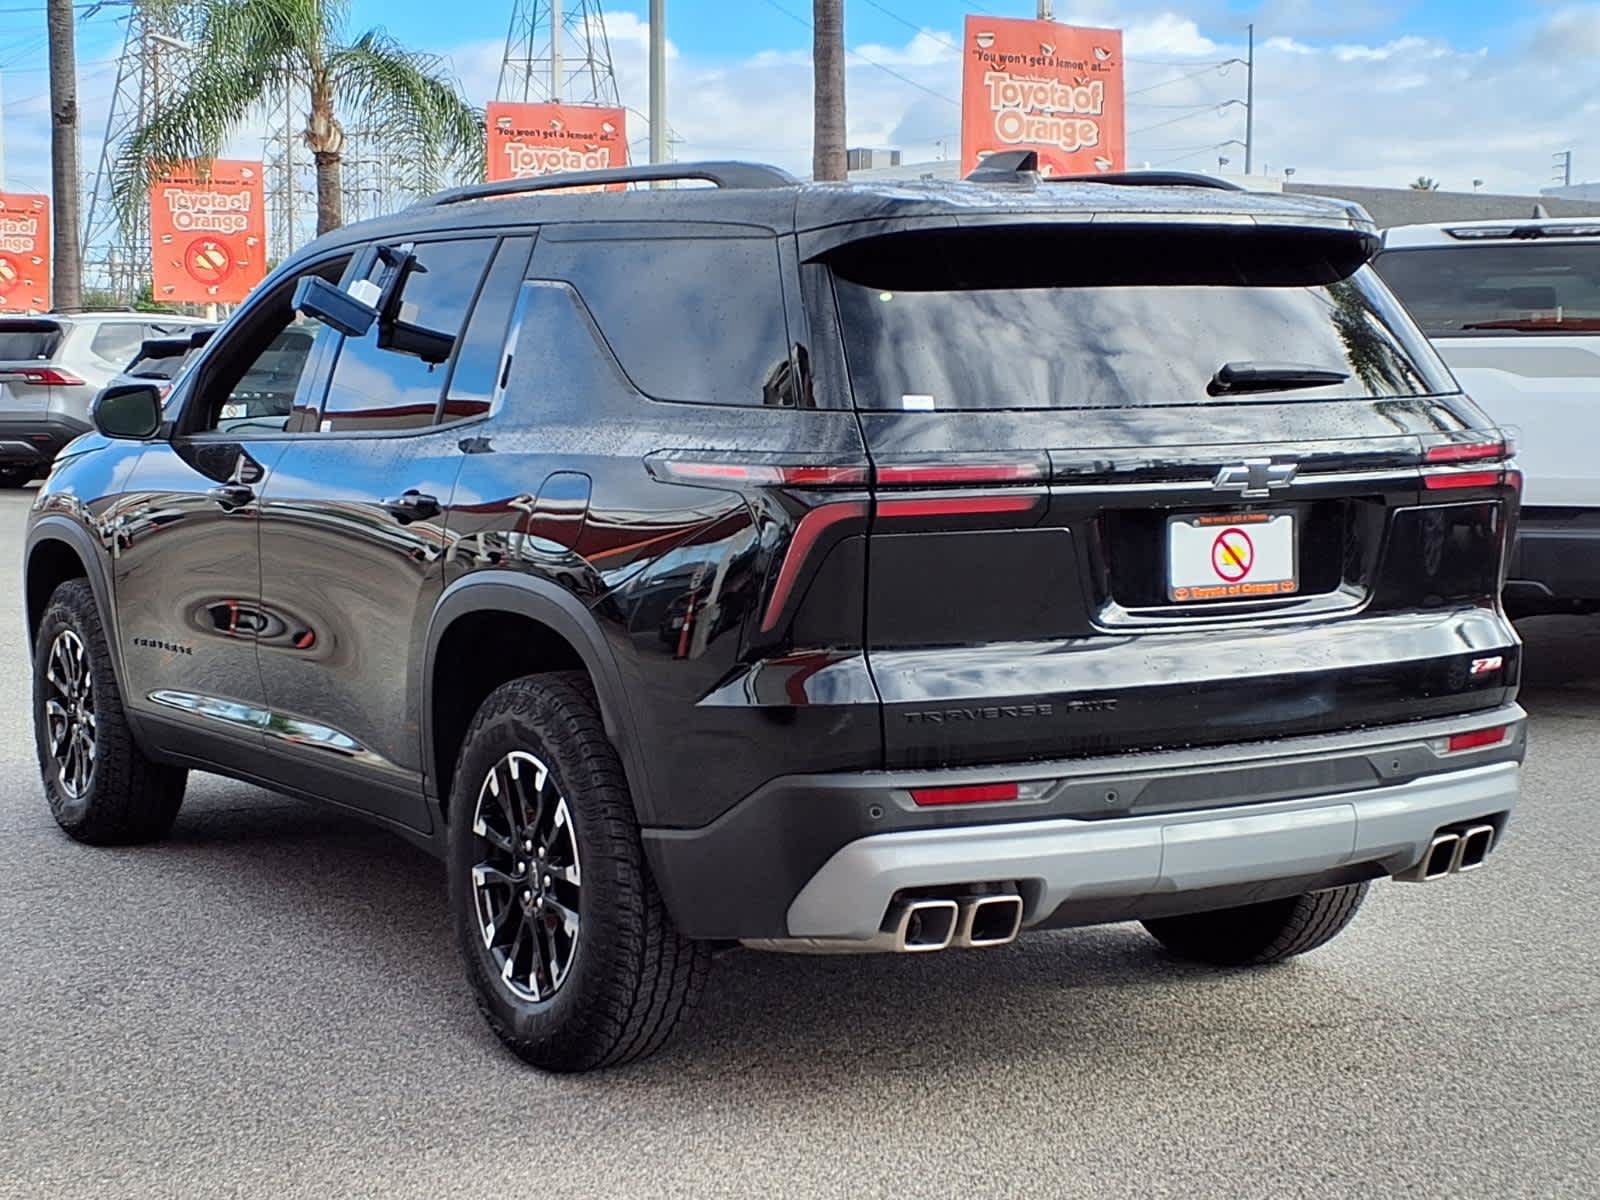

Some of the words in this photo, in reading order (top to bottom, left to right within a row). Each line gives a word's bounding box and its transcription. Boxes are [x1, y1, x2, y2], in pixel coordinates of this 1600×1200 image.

[999, 52, 1027, 64] won't
[1030, 54, 1046, 67] get
[1048, 57, 1054, 66] a
[984, 72, 1072, 114] Toyota
[1073, 80, 1103, 115] of
[517, 128, 540, 137] won't
[543, 129, 557, 139] get
[995, 110, 1099, 152] Orange
[505, 143, 583, 174] Toyota
[584, 148, 609, 172] of
[164, 188, 230, 212] Toyota
[230, 191, 251, 212] of
[18, 218, 37, 236] of
[172, 210, 248, 235] Orange
[903, 704, 1052, 724] TRAVERSE
